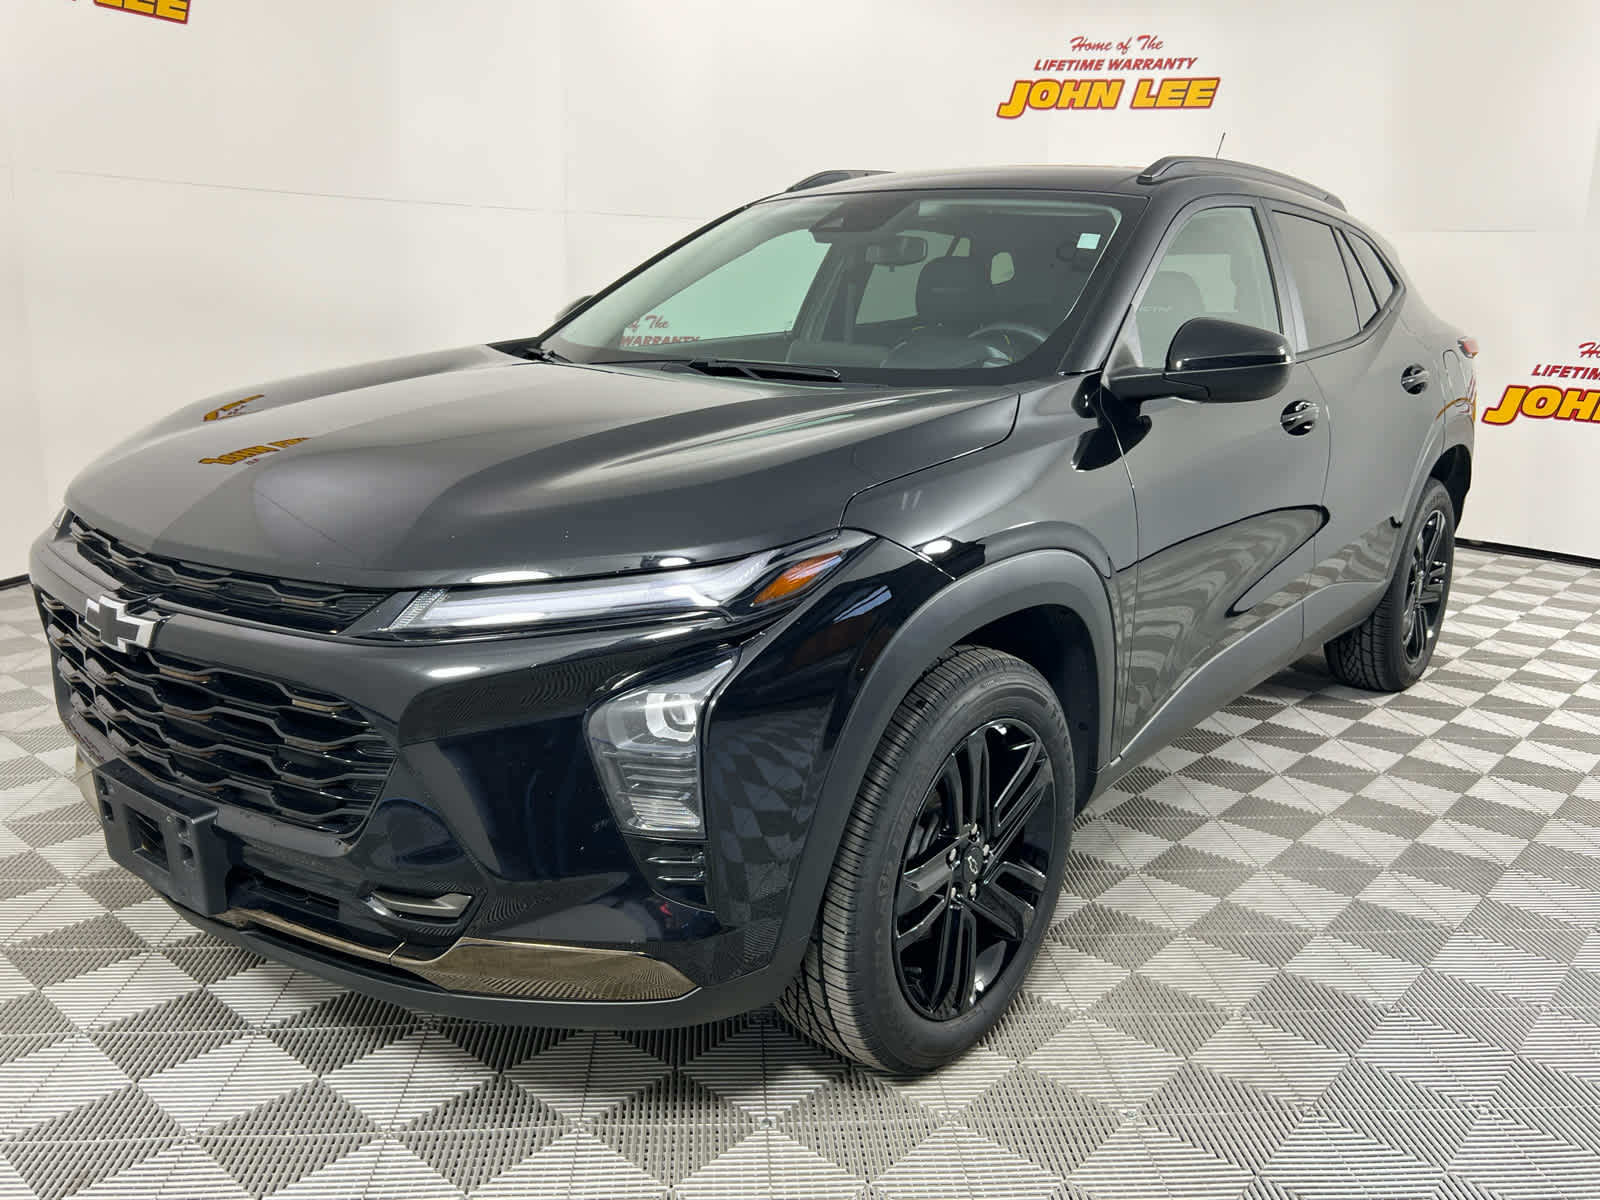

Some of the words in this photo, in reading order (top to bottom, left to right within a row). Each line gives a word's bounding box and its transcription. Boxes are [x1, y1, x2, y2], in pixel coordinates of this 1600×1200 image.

[1069, 36, 1112, 52] Home
[1116, 37, 1132, 55] of
[1137, 34, 1164, 50] The
[1034, 58, 1105, 71] LIFETIME
[1107, 57, 1198, 71] WARRANTY
[996, 78, 1125, 119] JOHN
[1130, 77, 1220, 109] LEE
